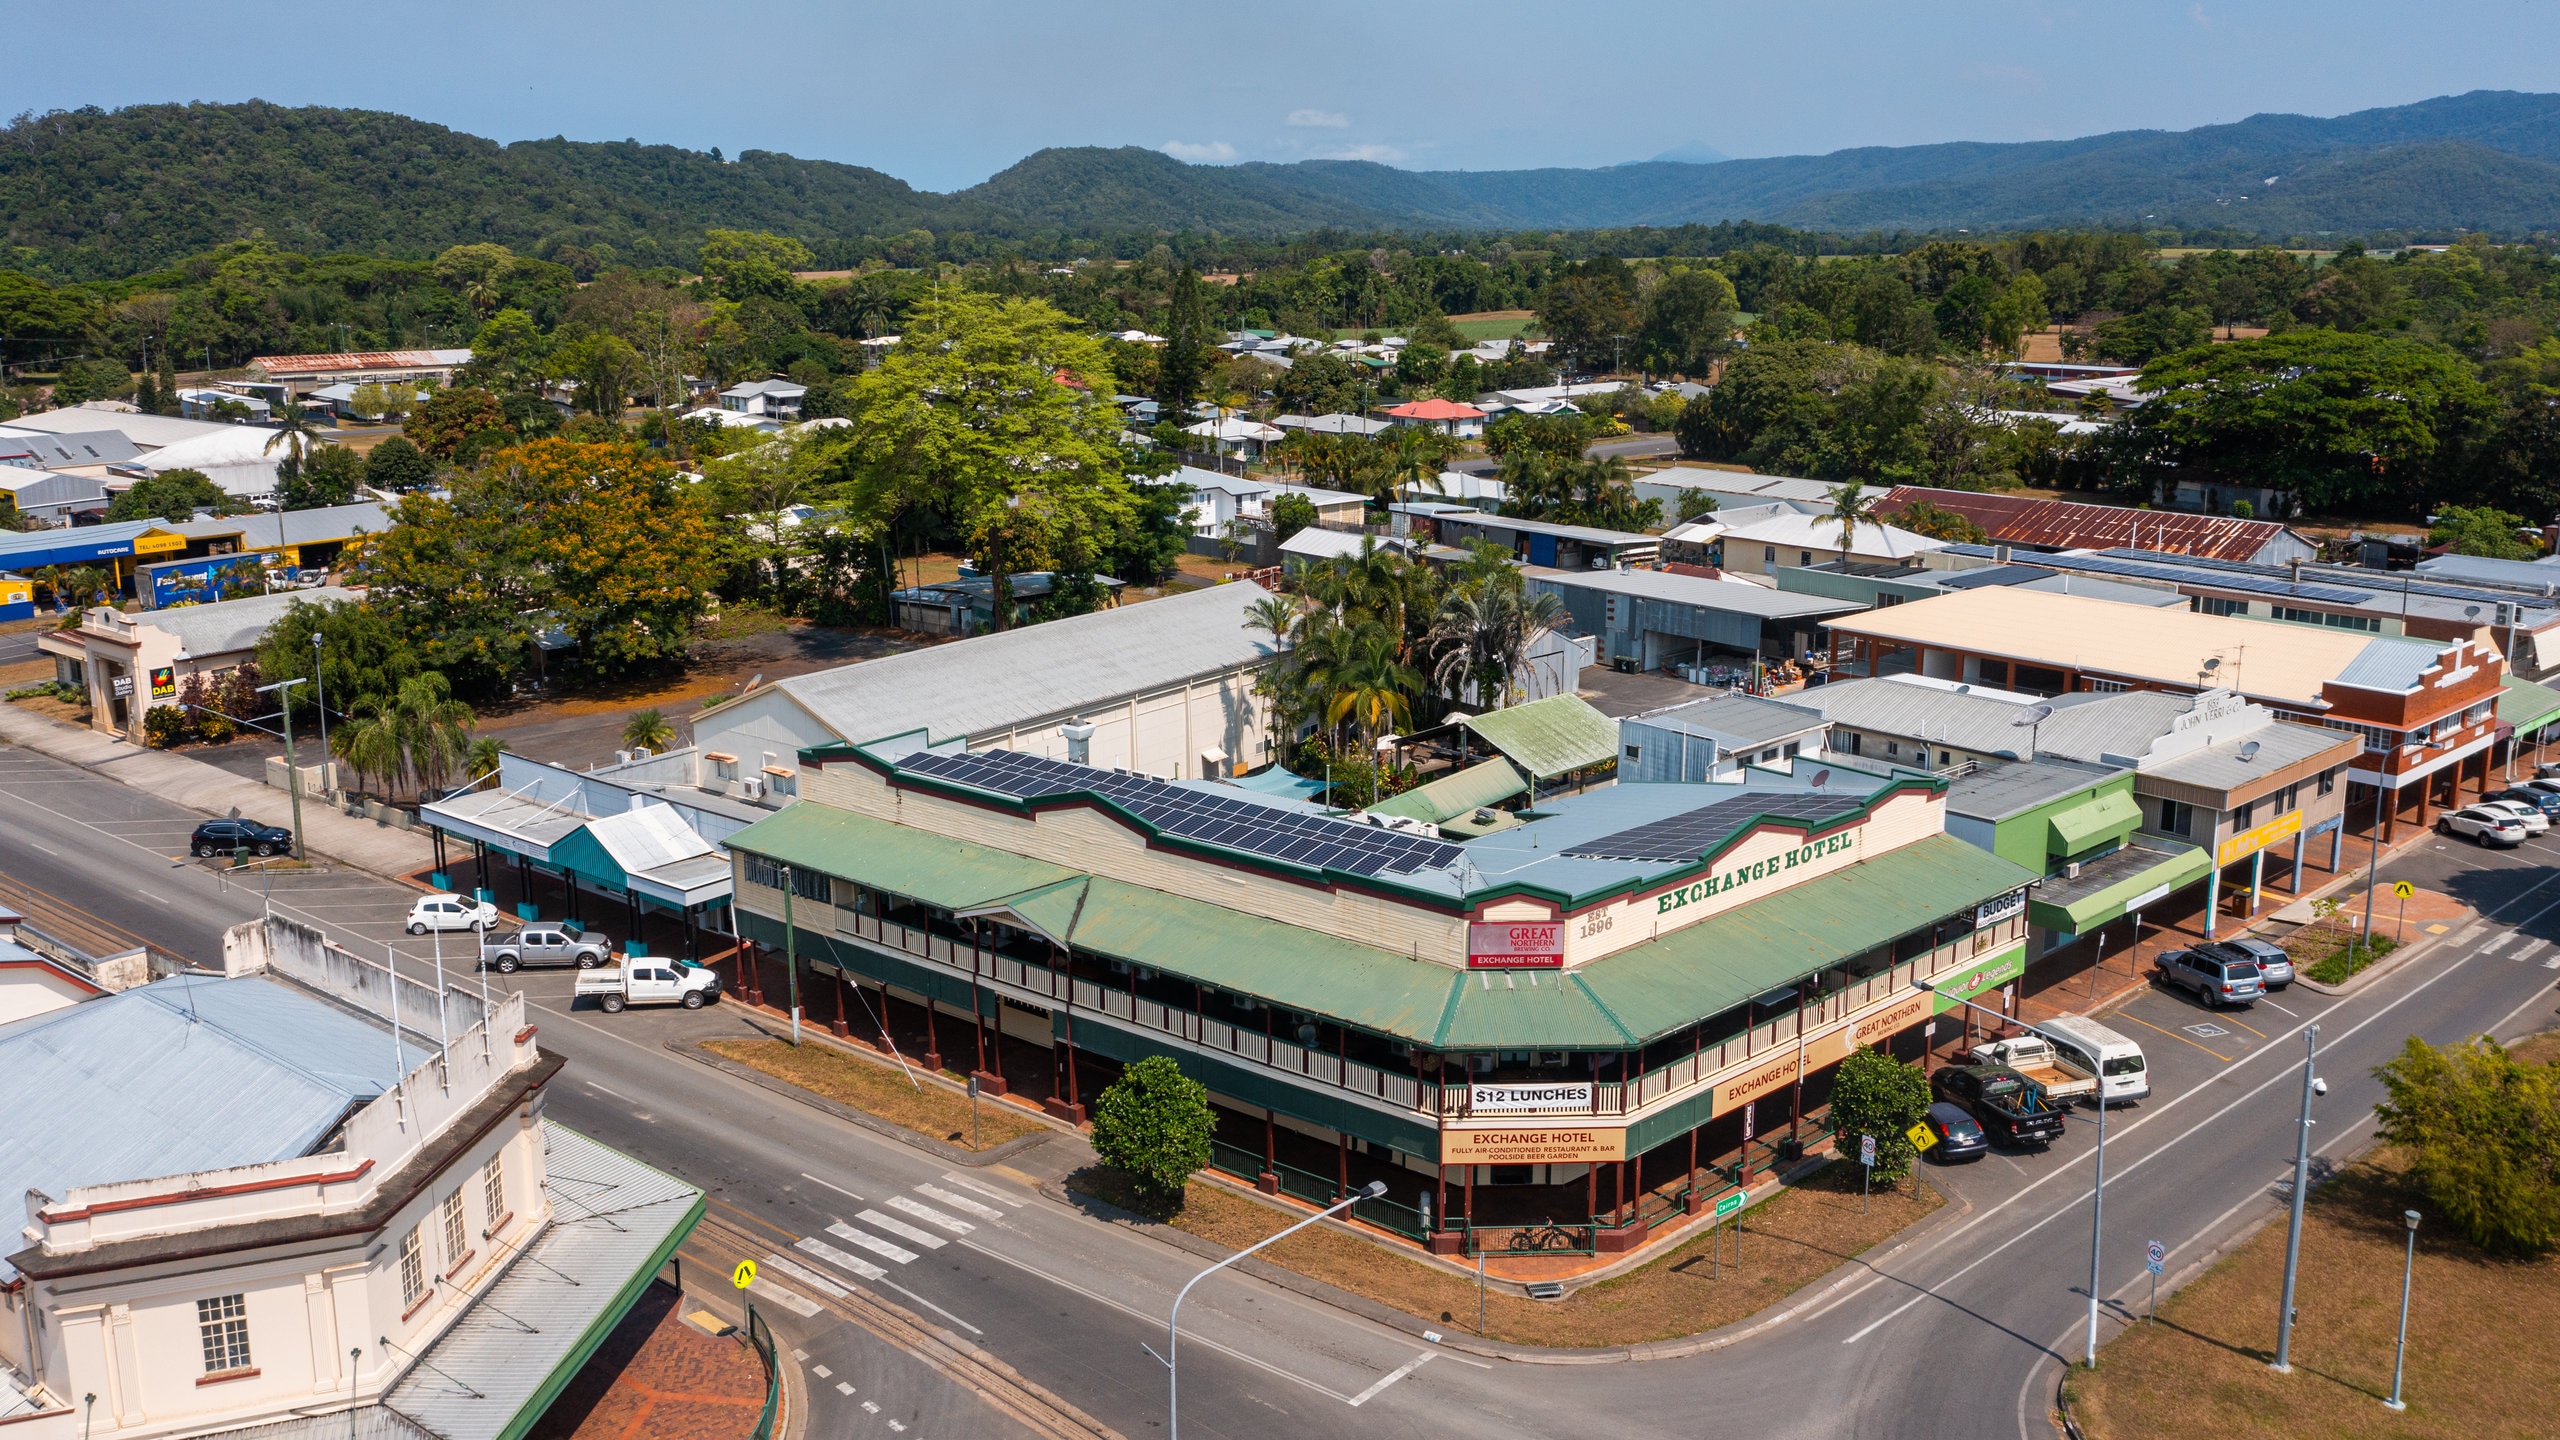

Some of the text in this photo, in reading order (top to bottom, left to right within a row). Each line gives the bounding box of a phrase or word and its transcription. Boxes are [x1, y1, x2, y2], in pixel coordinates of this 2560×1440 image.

[97, 546, 129, 555] AUTOCARE
[113, 677, 132, 687] DAB
[152, 684, 175, 696] DAB
[2180, 713, 2202, 731] JOHN
[1657, 831, 1853, 915] EXCHANGE HOTEL
[1983, 892, 2023, 918] BUDGET
[1586, 907, 1609, 923] EST
[1509, 927, 1556, 939] GREAT
[1580, 916, 1613, 939] 1896
[1510, 939, 1555, 947] NORTHERN
[1477, 956, 1525, 964] EXCHANGE
[1855, 1000, 1921, 1040] GREAT NORTHERN
[1728, 1067, 1781, 1101] EXCHANGE
[1475, 1088, 1588, 1103] $12 LUNCHES
[2026, 1117, 2053, 1127] RAM
[1473, 1133, 1595, 1144] EXCHANGE HOTEL
[1718, 1199, 1738, 1212] Cairns
[2150, 1249, 2162, 1258] 40
